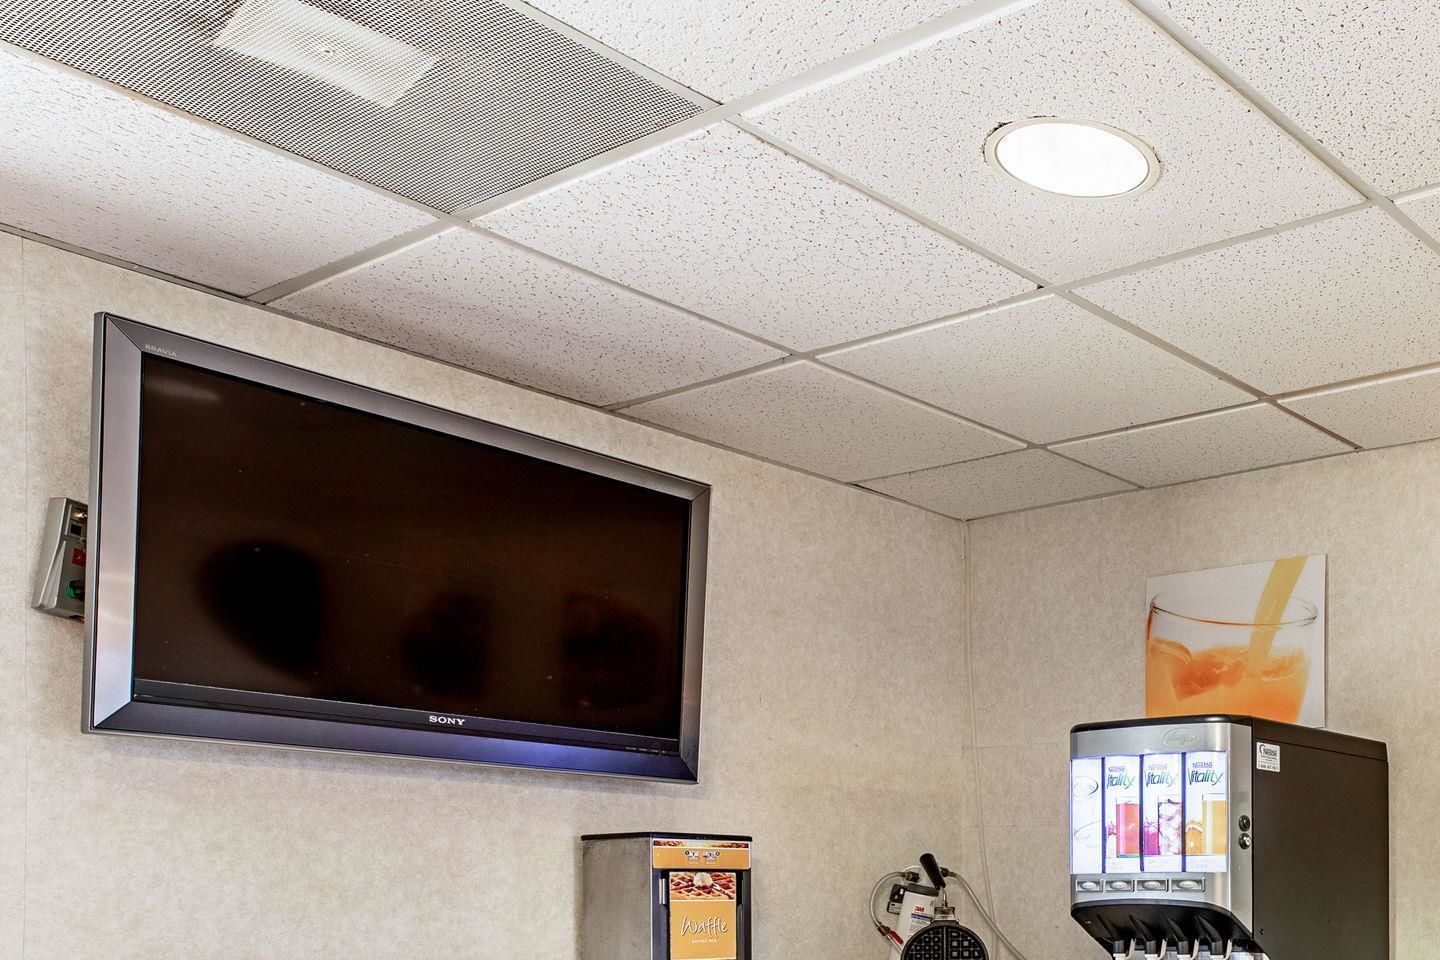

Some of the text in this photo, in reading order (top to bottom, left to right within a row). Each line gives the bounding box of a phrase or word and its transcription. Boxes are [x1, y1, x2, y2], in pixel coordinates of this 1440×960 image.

[145, 344, 177, 357] BRAVIA
[428, 715, 466, 726] SONY
[681, 916, 728, 938] Waffle
